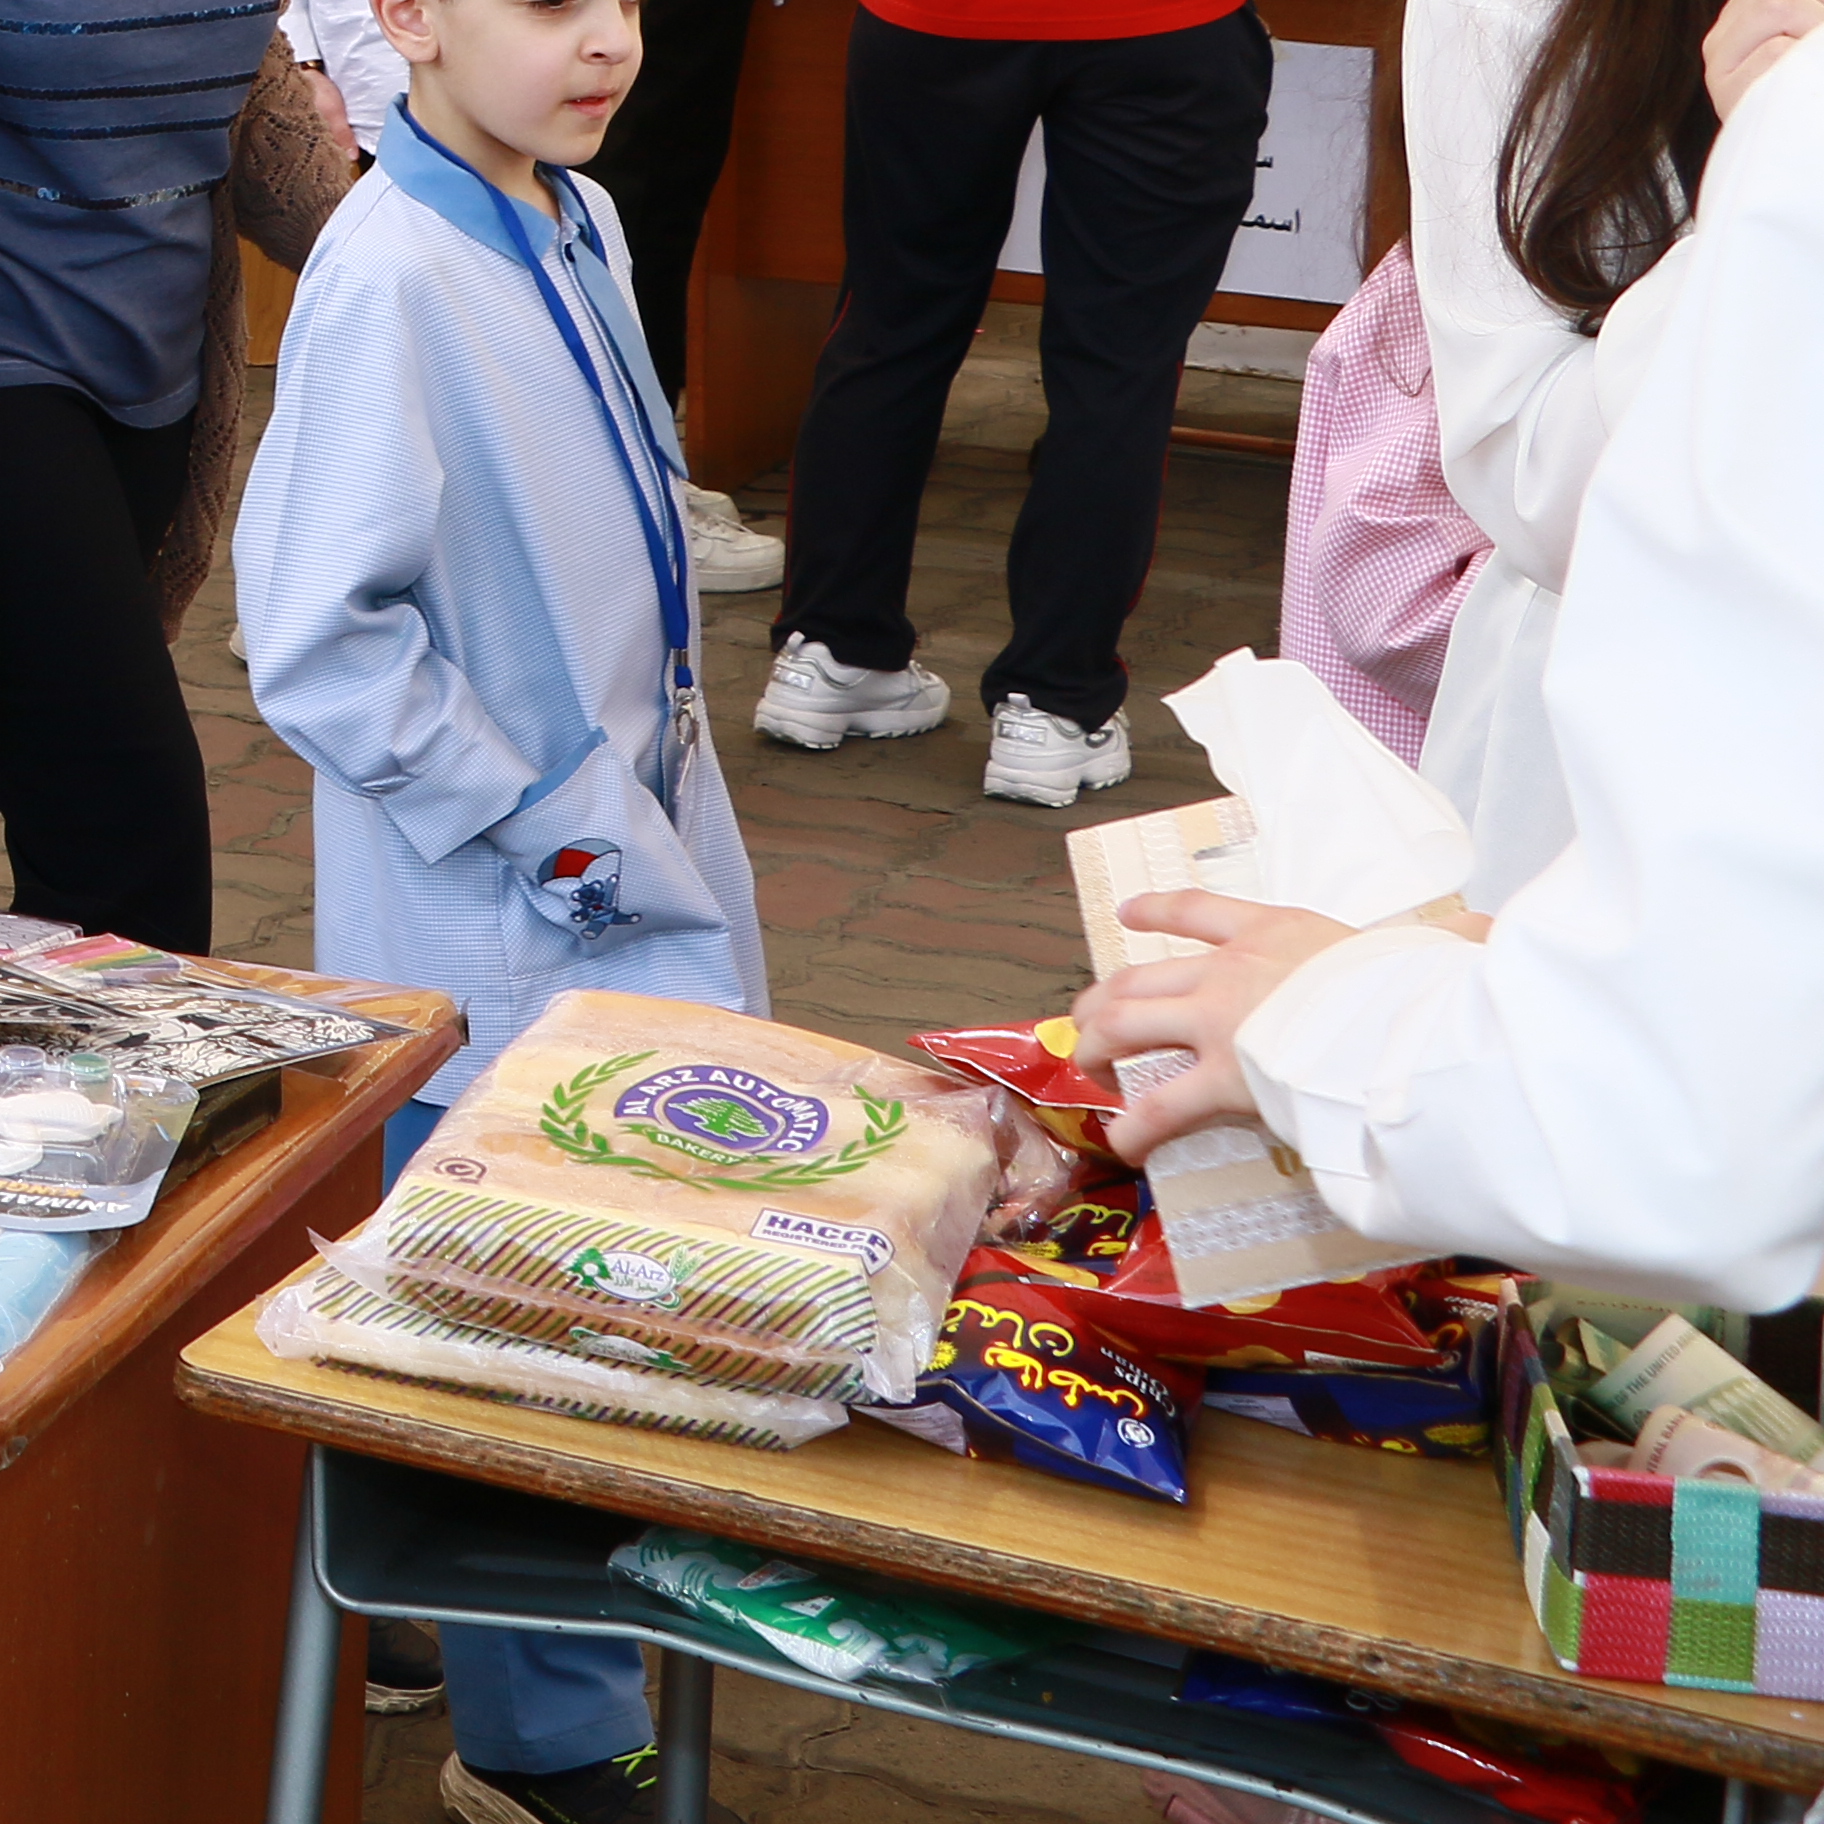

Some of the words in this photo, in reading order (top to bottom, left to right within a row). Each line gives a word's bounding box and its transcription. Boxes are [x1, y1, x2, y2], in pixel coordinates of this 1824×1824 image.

[623, 1097, 651, 1115] AL
[639, 1069, 700, 1096] ARZ
[709, 1069, 819, 1152] AUTOMATIC
[656, 1133, 741, 1164] BAKERY
[761, 1227, 848, 1251] REGISTERED
[766, 1214, 888, 1251] HACCP
[610, 1259, 665, 1284] Al-Arz
[982, 1340, 1148, 1418] بطاطس
[1100, 1346, 1170, 1396] Oman
[1113, 1364, 1176, 1418] Chips
[1625, 1372, 1650, 1396] THE
[1646, 1345, 1682, 1379] UNITED
